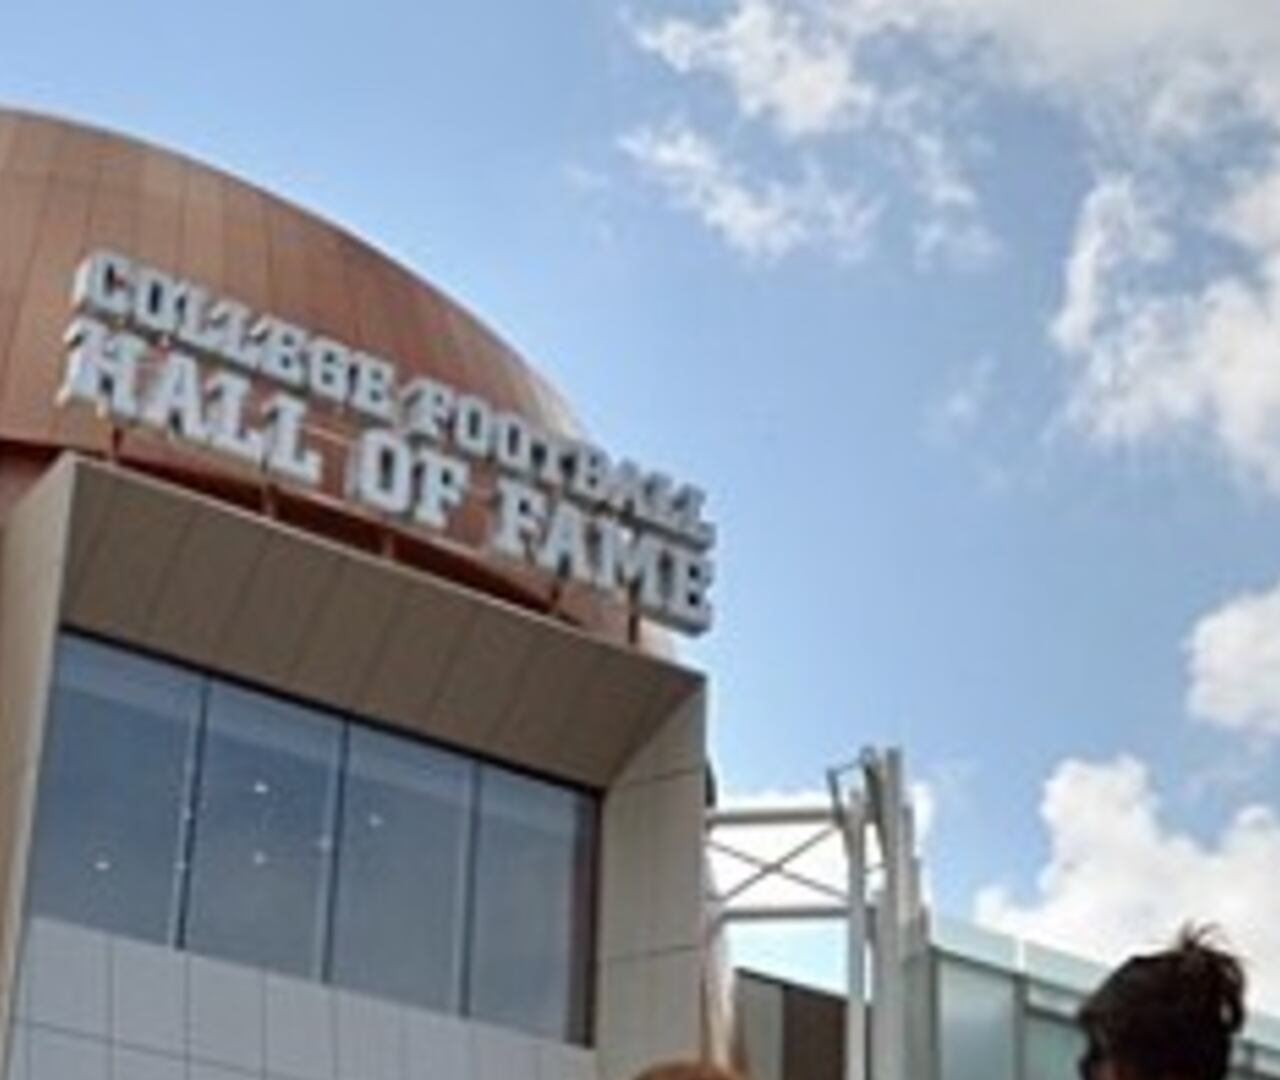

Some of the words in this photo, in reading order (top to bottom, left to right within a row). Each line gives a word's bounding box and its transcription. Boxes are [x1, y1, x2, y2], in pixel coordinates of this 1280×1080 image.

[58, 315, 322, 484] HALL
[350, 427, 470, 530] OF
[492, 477, 715, 634] FAME
[74, 251, 396, 422] COLLEGE
[398, 377, 716, 547] FOOTBALL
